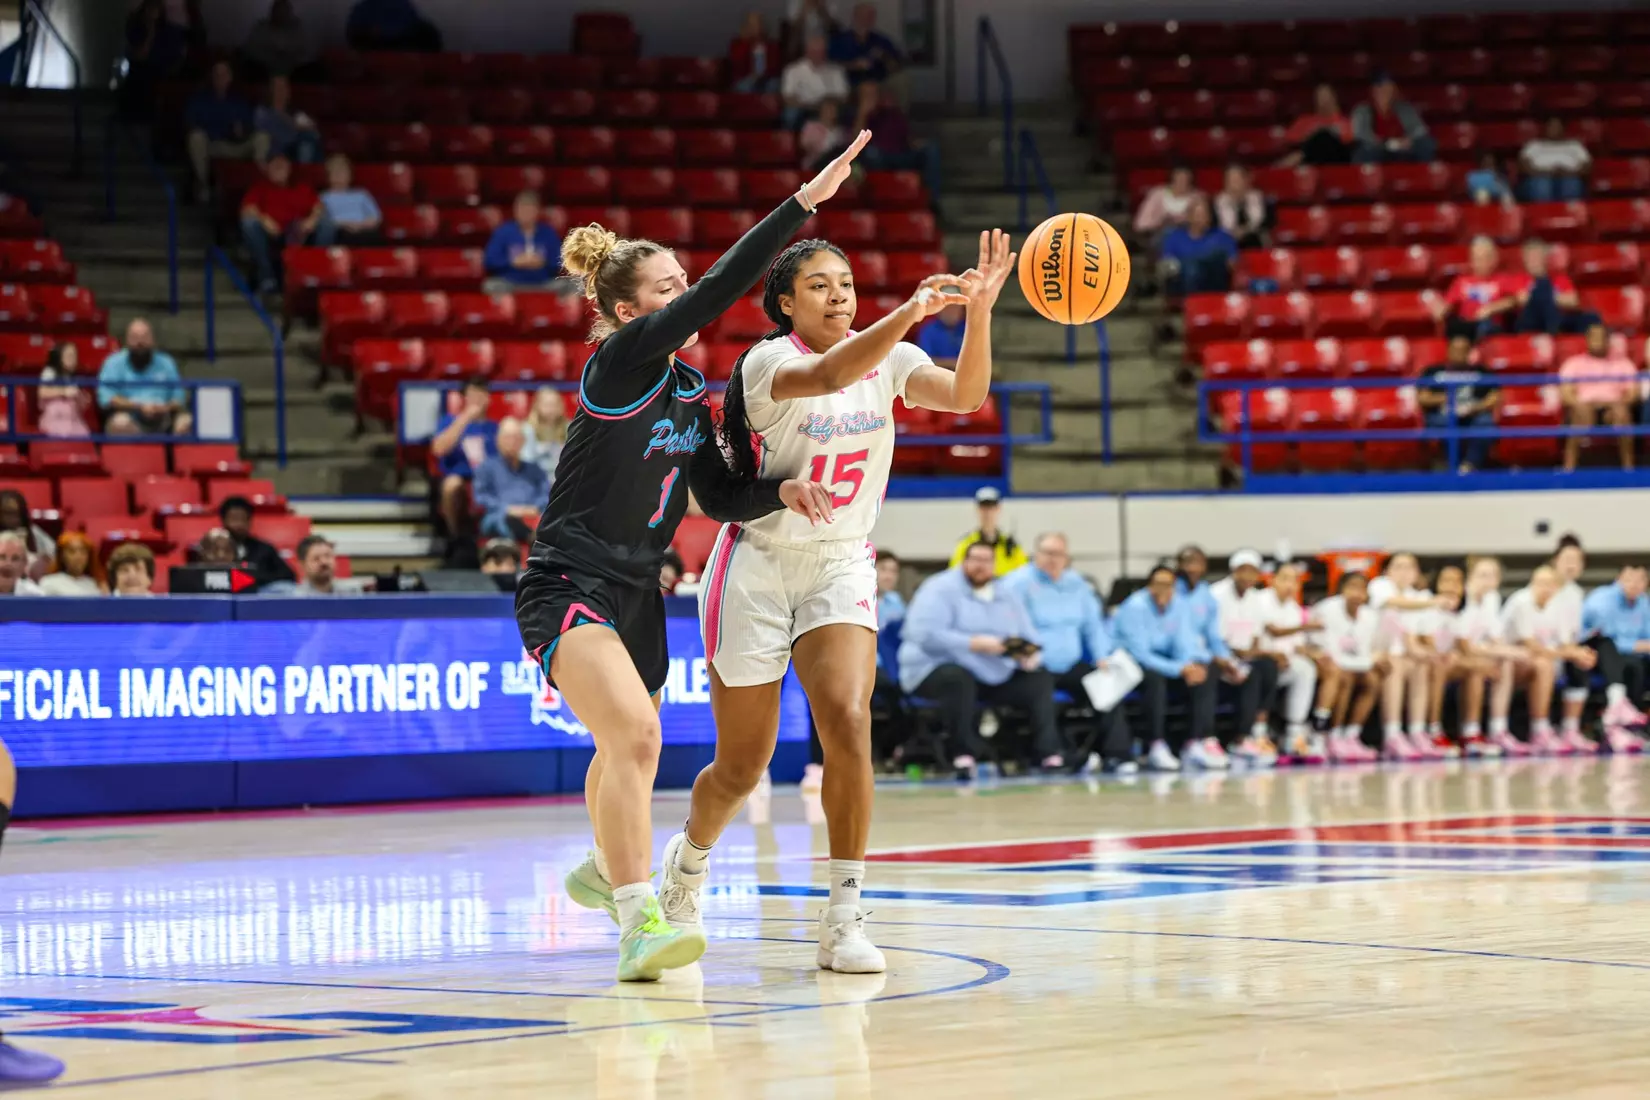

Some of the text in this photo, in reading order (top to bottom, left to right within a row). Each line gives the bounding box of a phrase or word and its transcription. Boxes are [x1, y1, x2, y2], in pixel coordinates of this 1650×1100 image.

[1042, 227, 1067, 302] Wilson
[798, 412, 836, 446] Lady
[648, 466, 680, 529] 1
[809, 447, 870, 510] 15
[119, 664, 276, 718] IMAGING
[283, 663, 441, 715] PARTNER
[445, 660, 490, 711] OF
